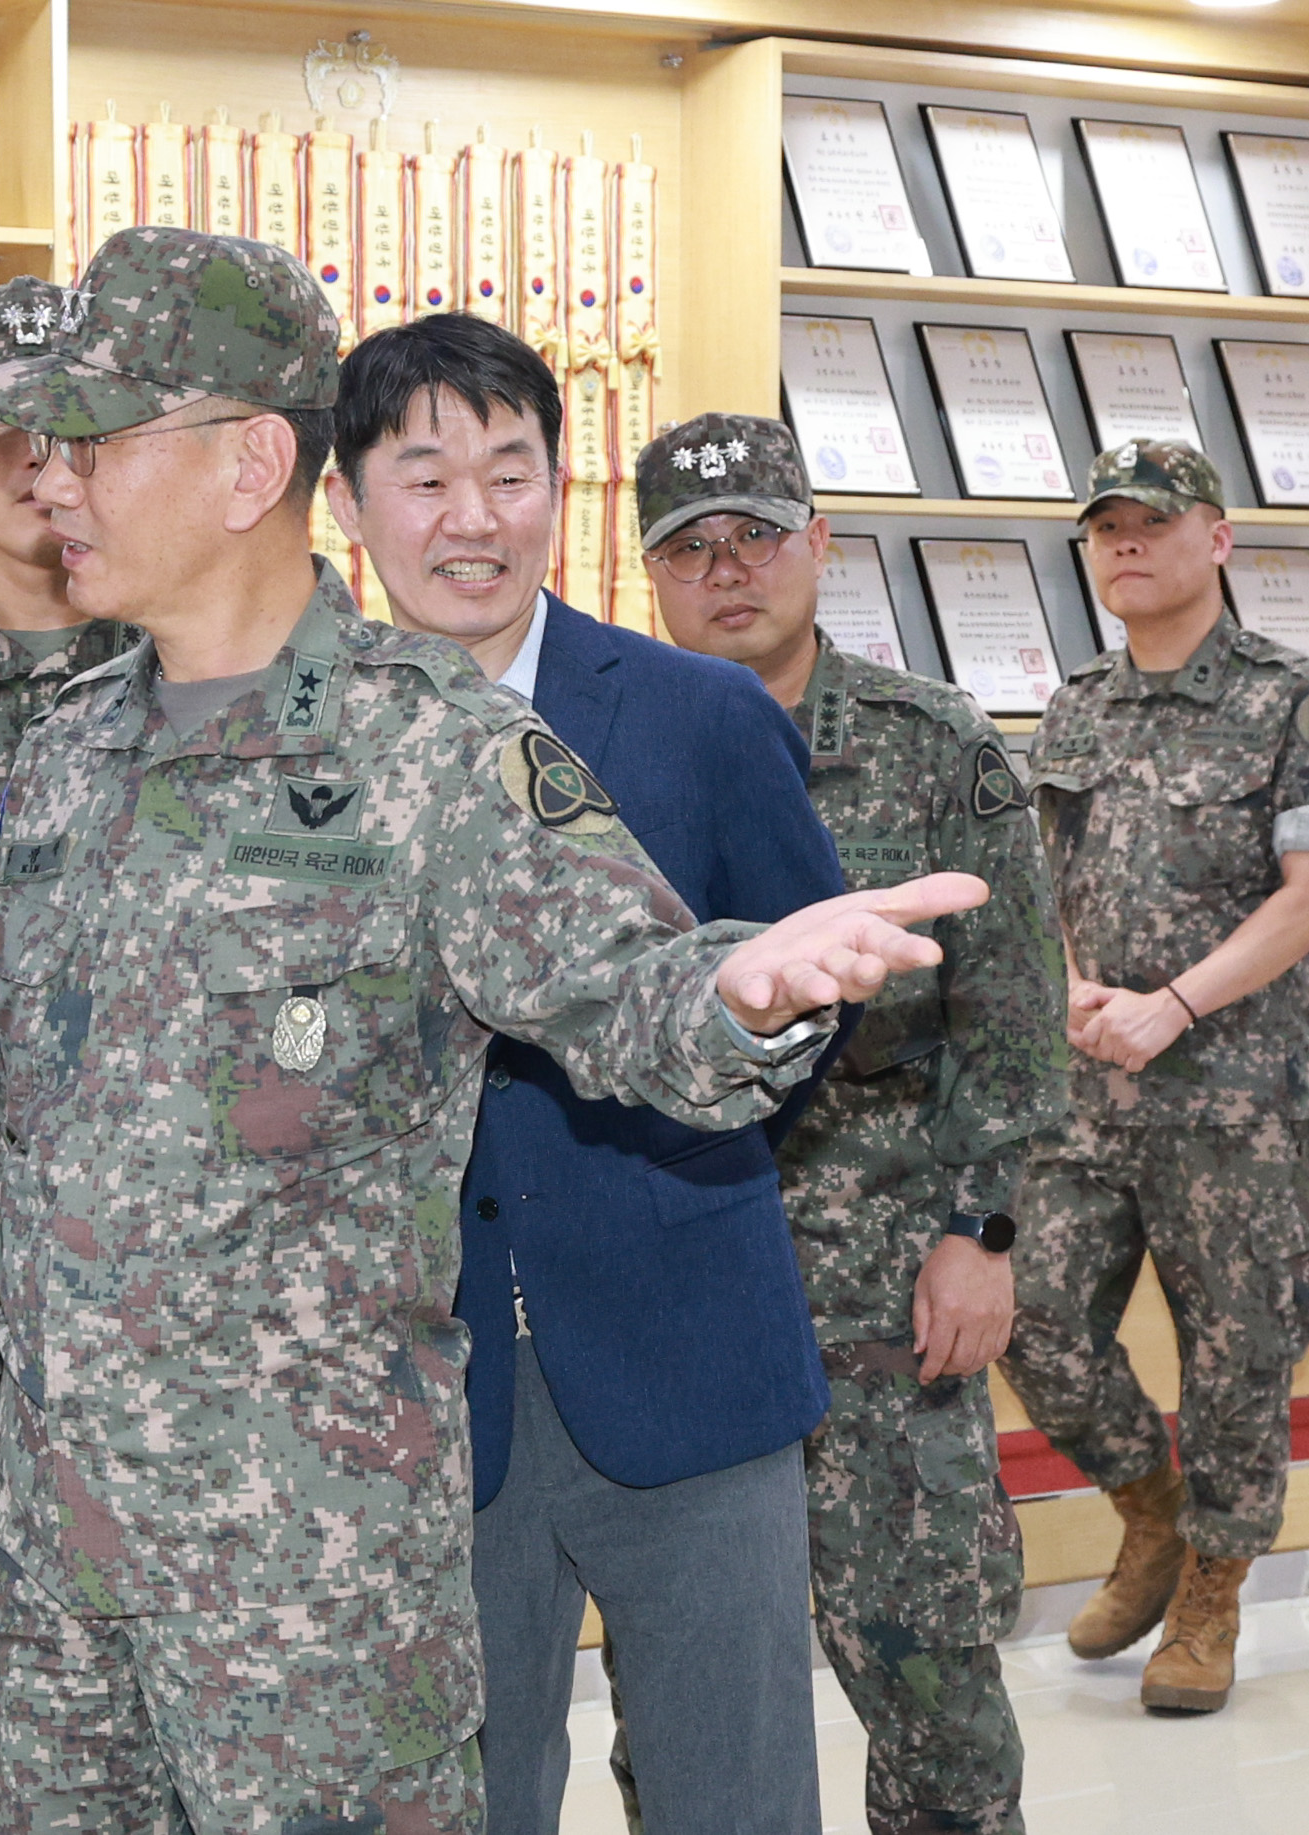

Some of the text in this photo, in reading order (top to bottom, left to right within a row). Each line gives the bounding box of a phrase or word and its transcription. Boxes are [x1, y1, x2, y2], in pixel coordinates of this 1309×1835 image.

[233, 845, 385, 876] 대한민국 육군 ROKA
[855, 847, 878, 861] 육군
[881, 848, 911, 862] ROKA
